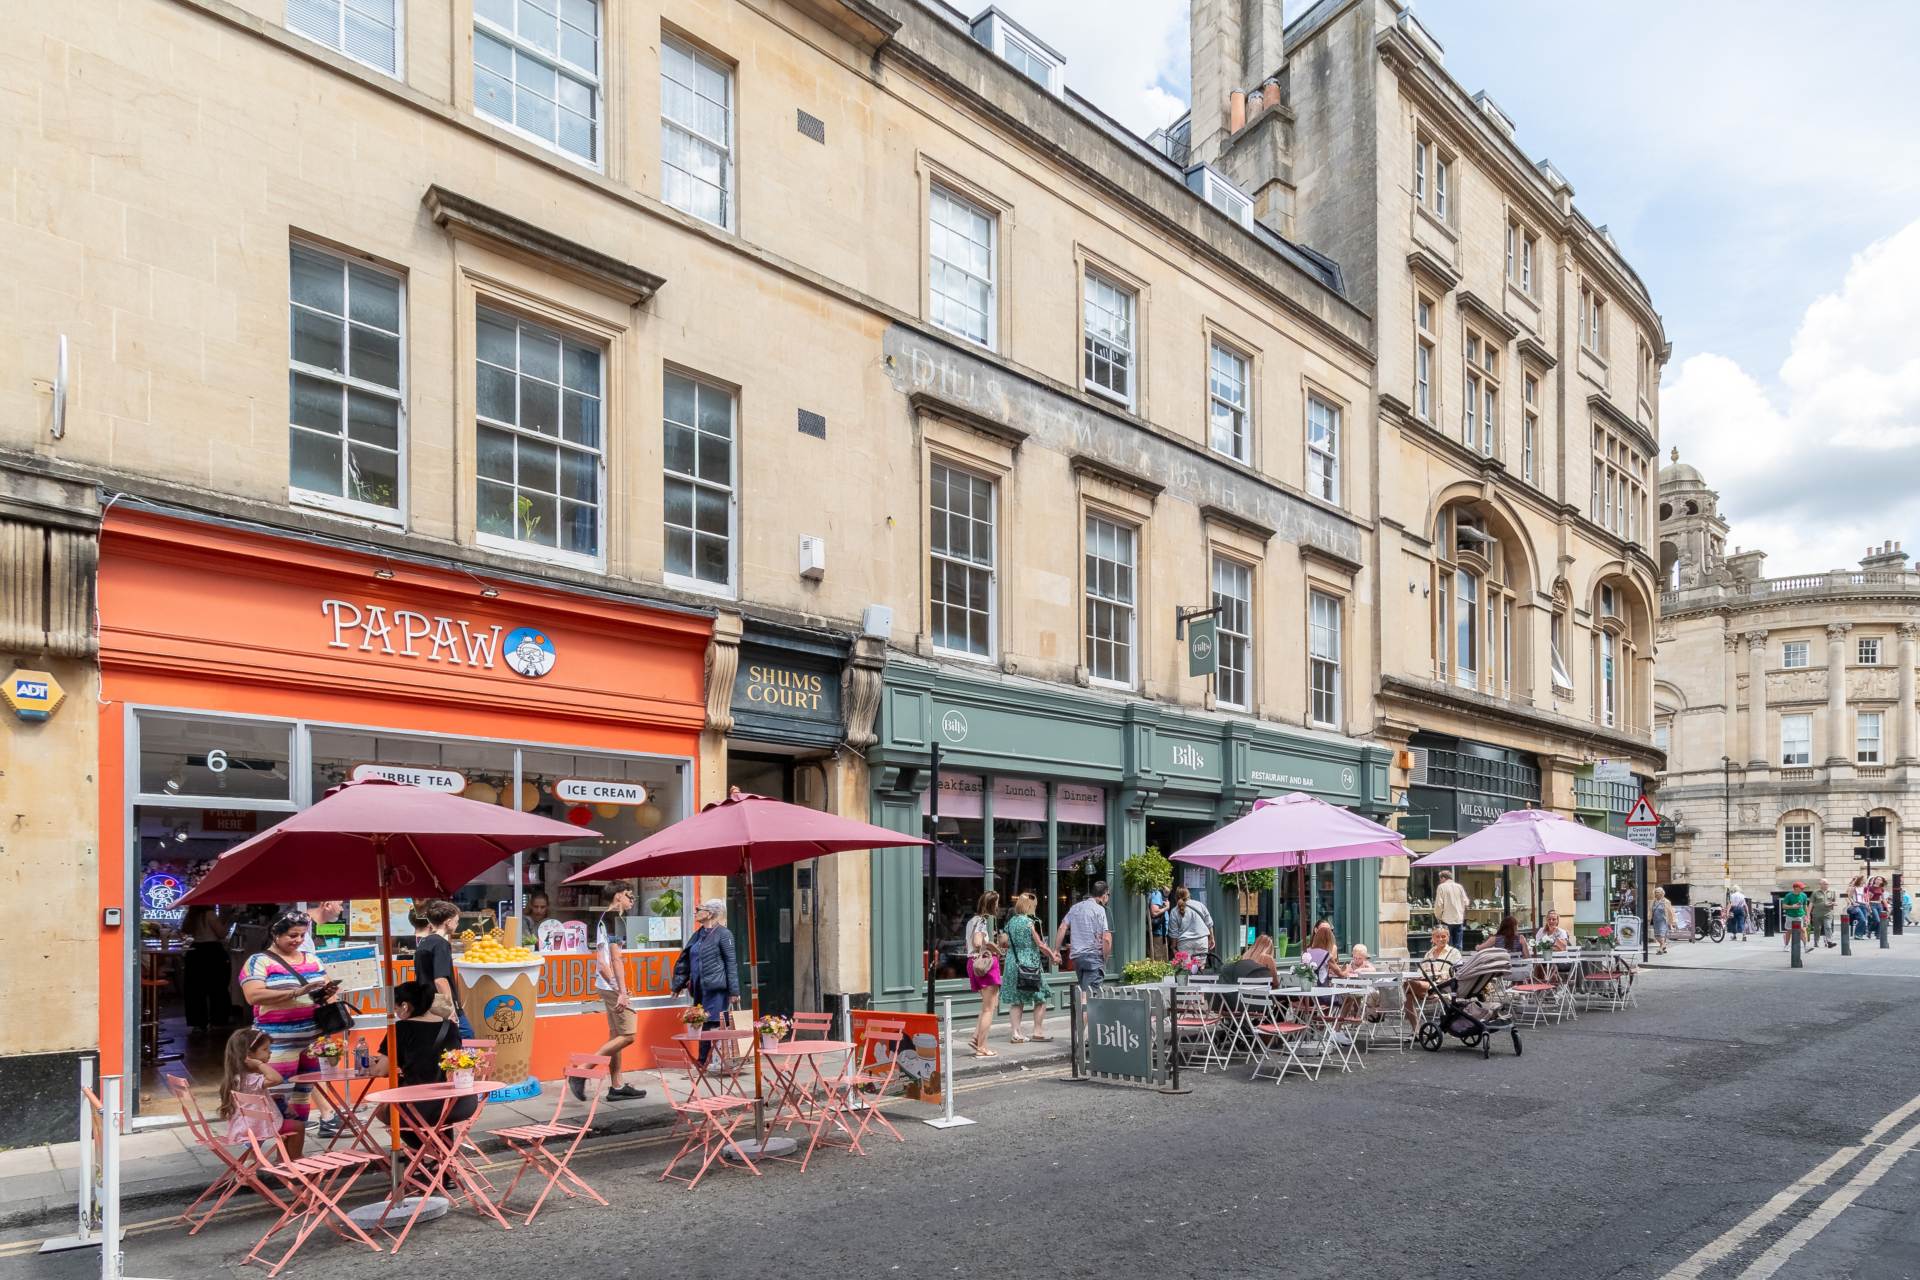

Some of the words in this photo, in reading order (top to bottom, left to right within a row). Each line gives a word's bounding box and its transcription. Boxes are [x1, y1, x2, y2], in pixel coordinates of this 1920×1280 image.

[322, 599, 502, 668] PAPAW
[749, 666, 821, 692] SHUMS
[16, 683, 48, 697] ADT
[747, 684, 822, 710] COURT
[207, 749, 228, 772] 6
[1172, 744, 1204, 770] Bill's
[427, 775, 452, 787] TEA
[936, 779, 984, 792] eakfast
[1251, 770, 1288, 784] RESTAURANT
[1289, 774, 1301, 785] AND
[1302, 777, 1313, 787] BAR
[567, 784, 587, 796] ICE
[593, 785, 636, 799] CREAM
[1005, 784, 1036, 797] Lunch
[1063, 790, 1098, 803] Dinner
[1460, 803, 1482, 816] MILES
[143, 909, 184, 920] PAPAW
[633, 955, 675, 995] TEA
[1096, 1019, 1140, 1053] Bill's
